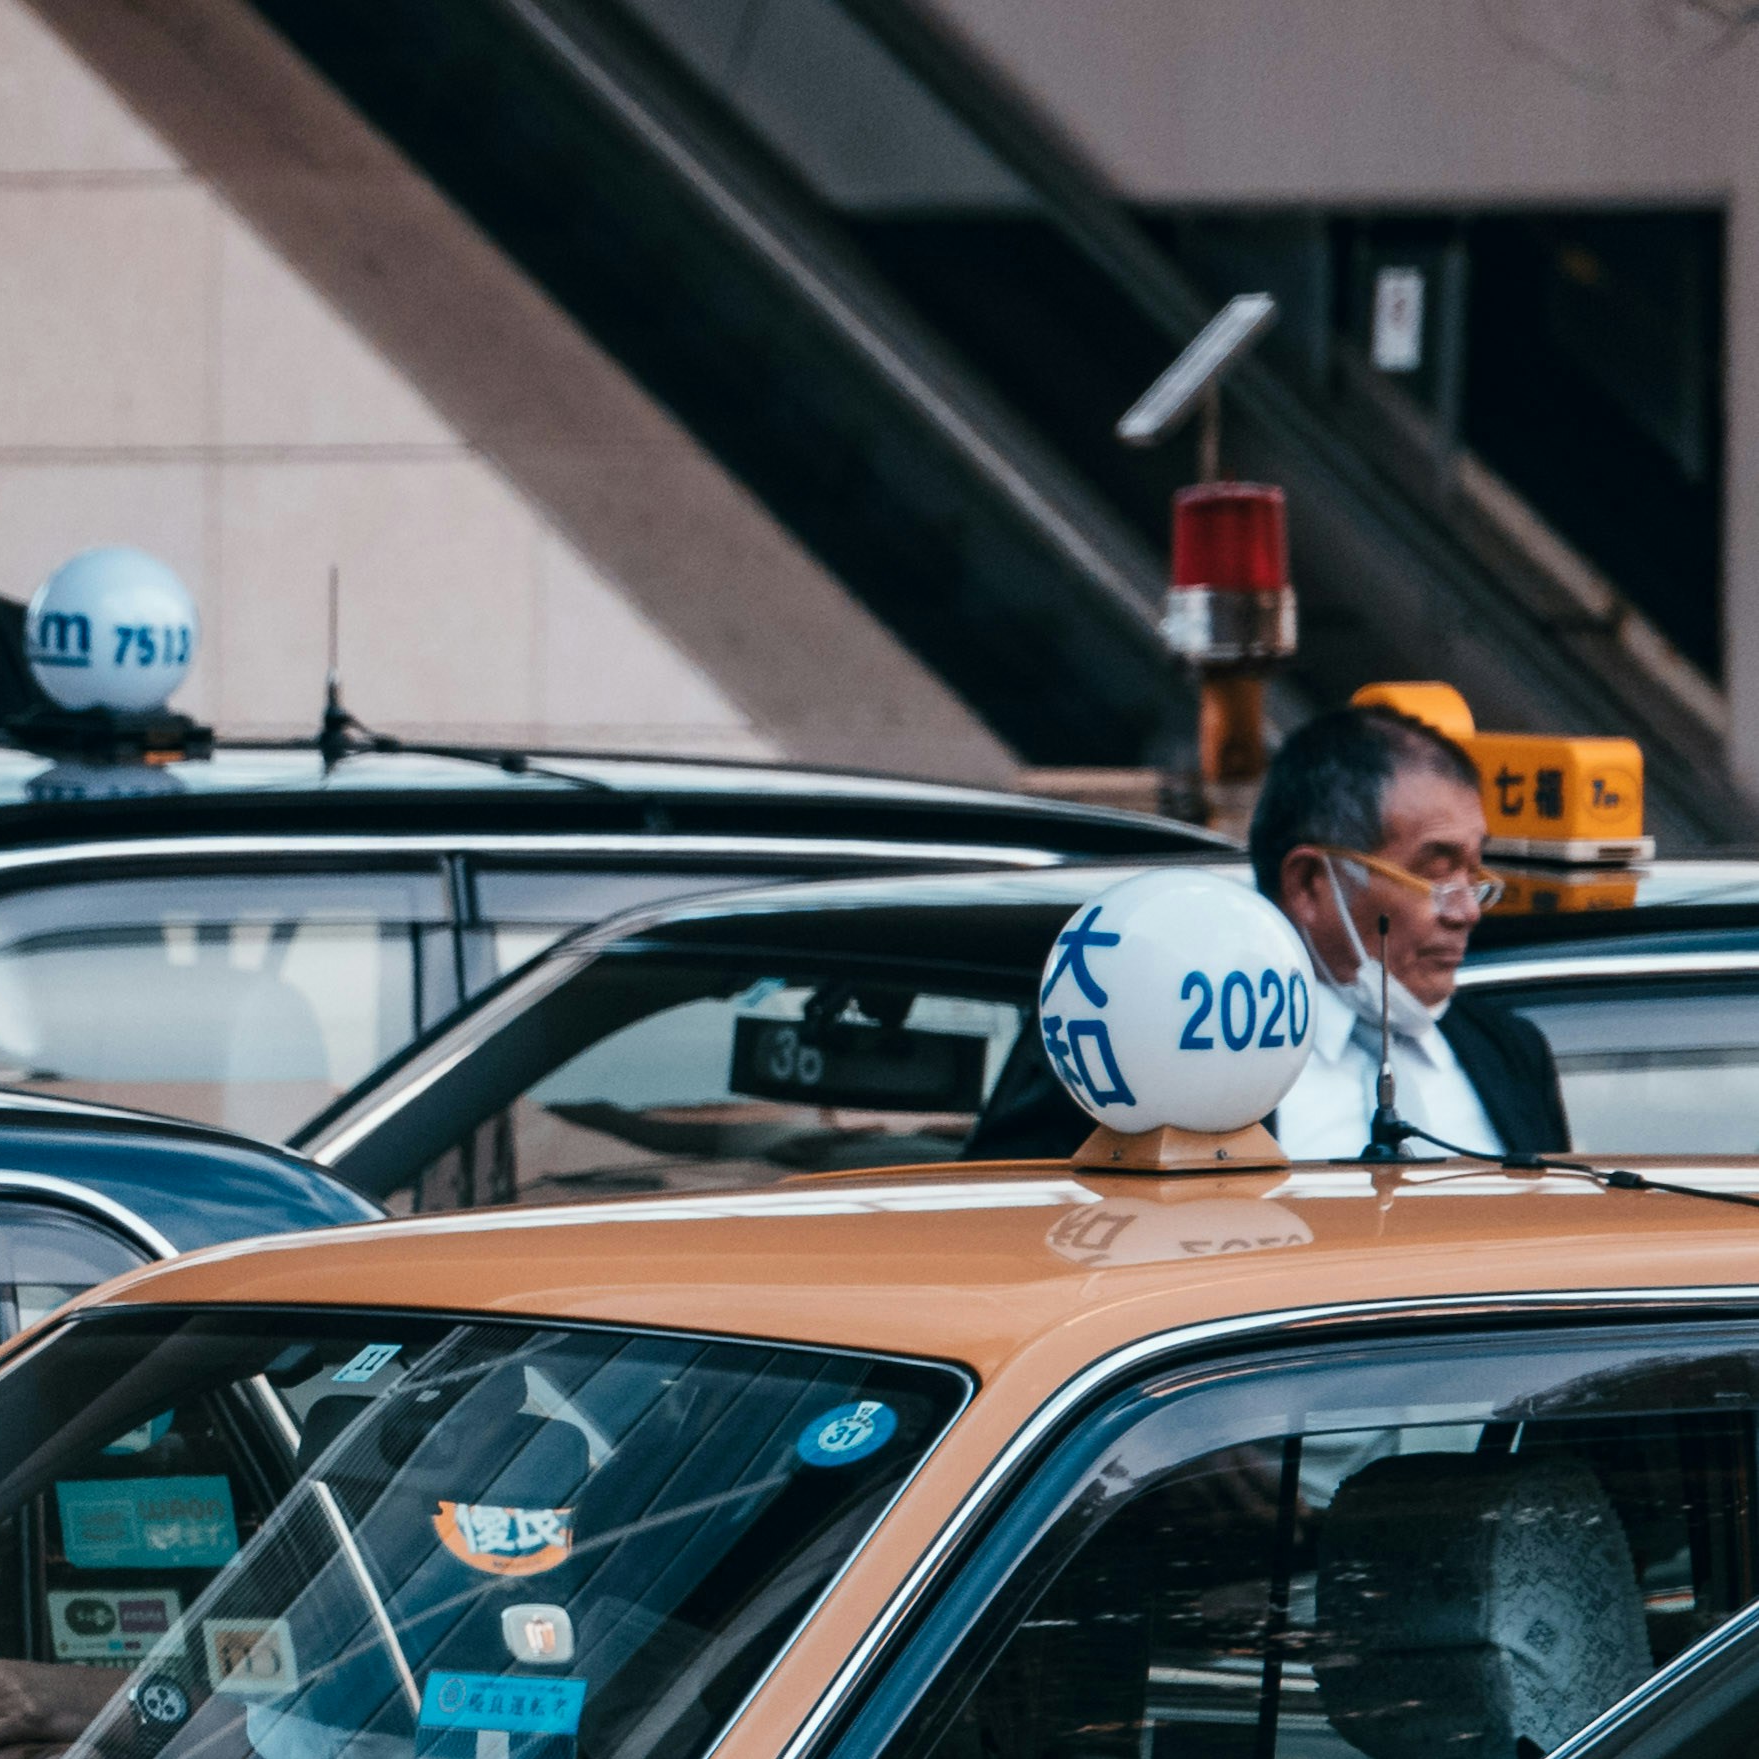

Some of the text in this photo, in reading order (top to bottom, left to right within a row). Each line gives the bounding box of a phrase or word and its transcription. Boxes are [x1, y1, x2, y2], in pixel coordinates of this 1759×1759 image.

[1041, 905, 1137, 1112] 大和
[1179, 967, 1309, 1052] 2020
[826, 1425, 862, 1446] 31
